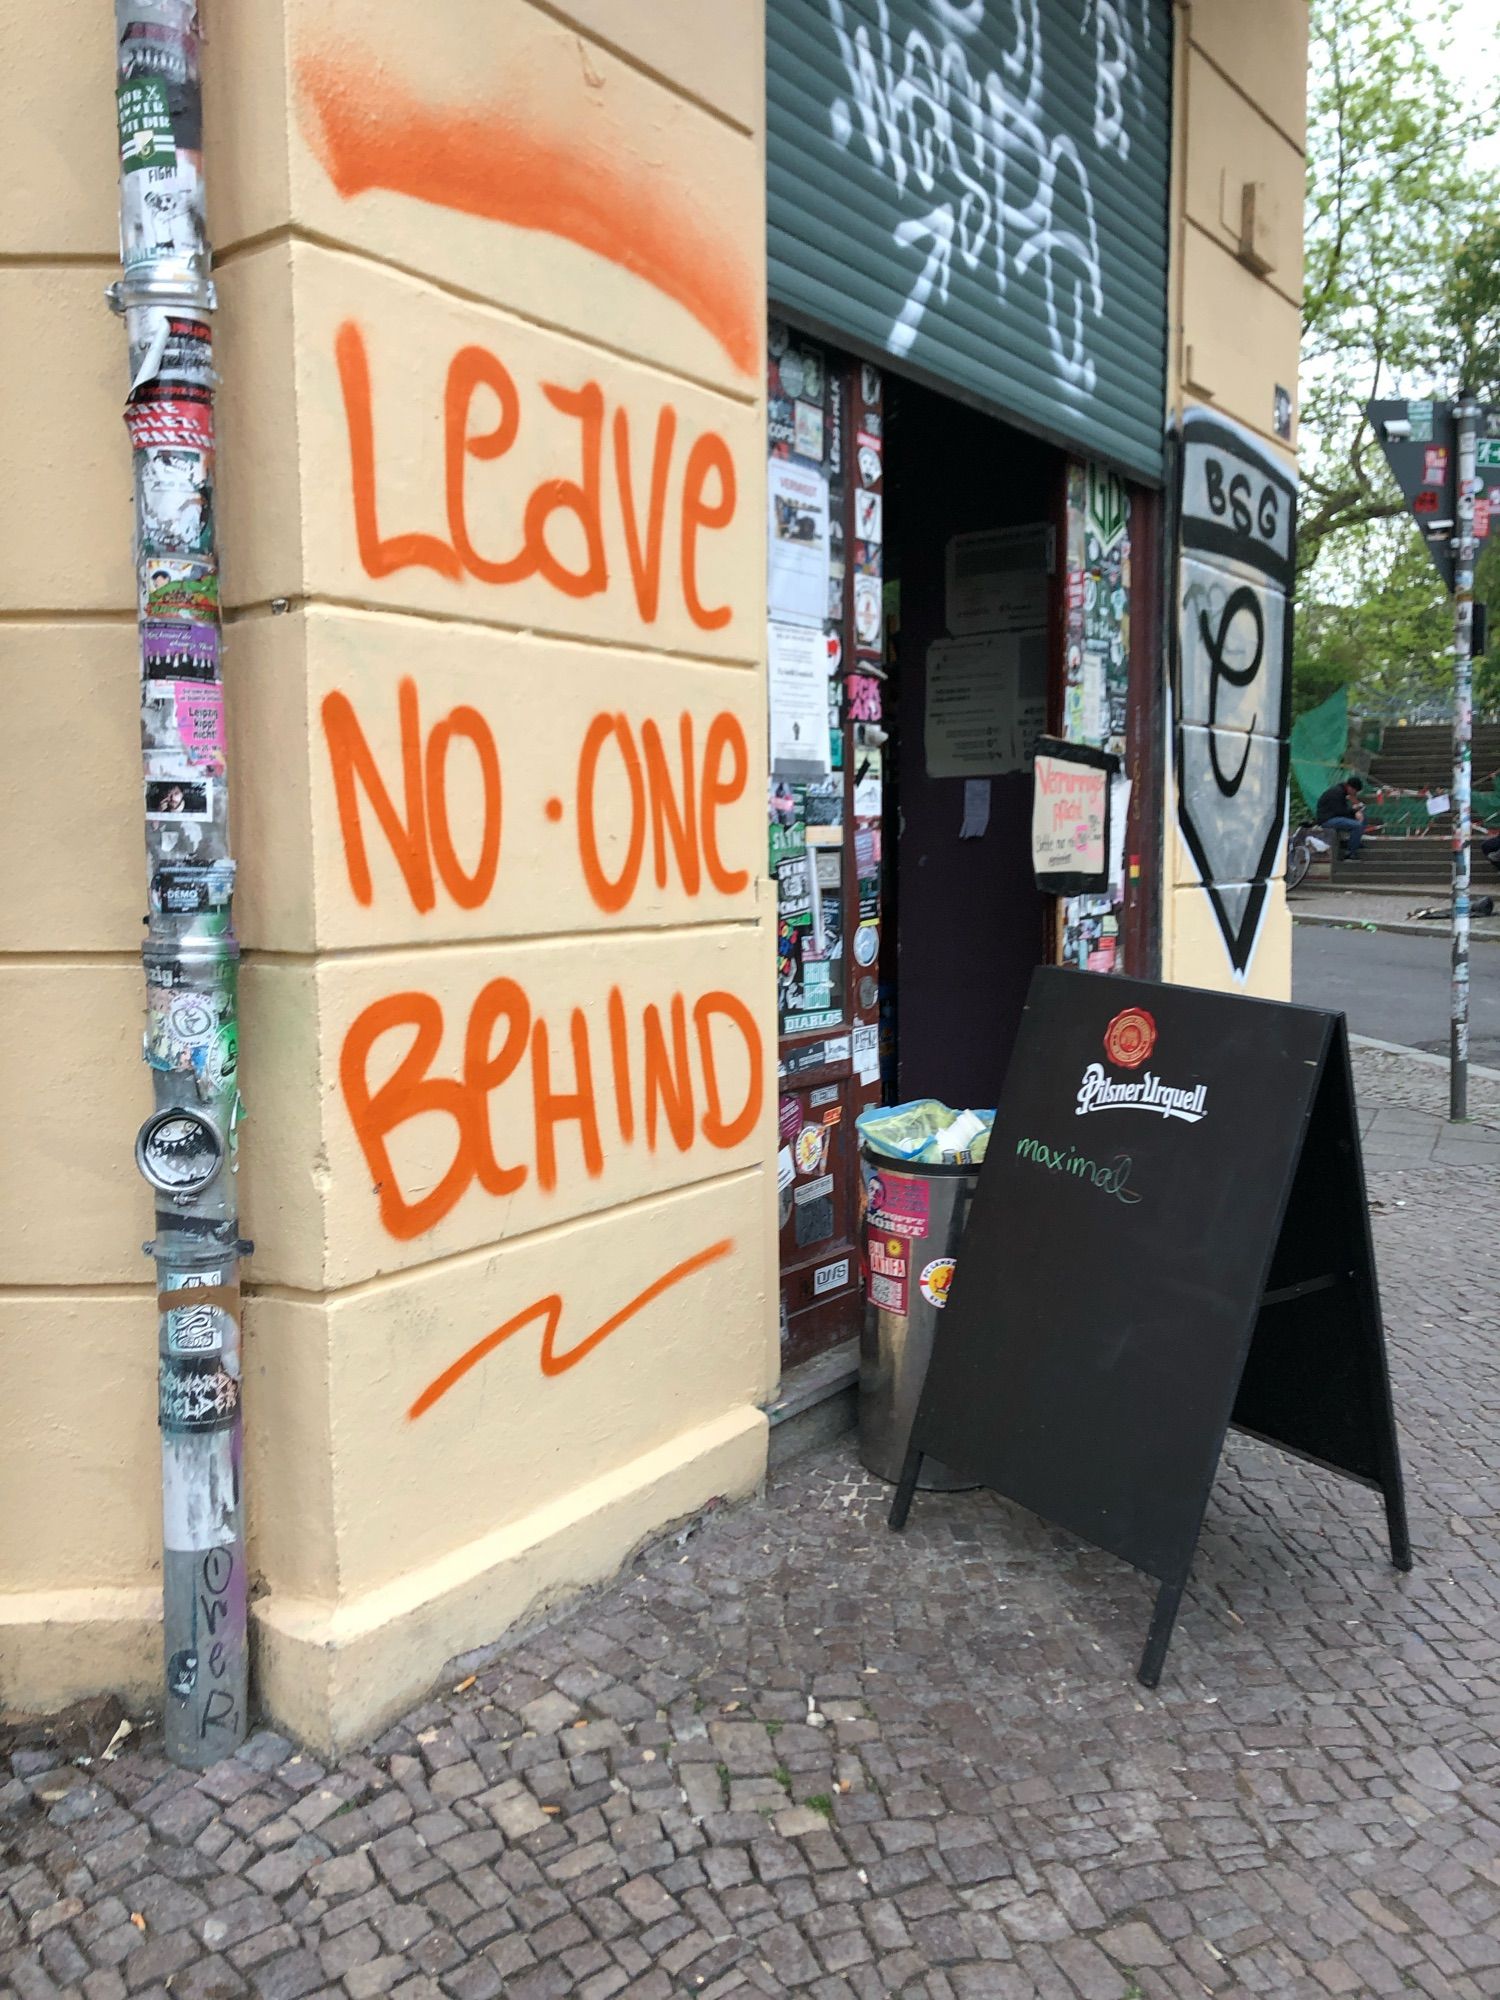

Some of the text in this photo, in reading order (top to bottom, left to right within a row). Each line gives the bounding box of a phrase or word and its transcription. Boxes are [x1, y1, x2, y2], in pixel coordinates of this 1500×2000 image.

[1205, 457, 1279, 539] BSG
[188, 707, 218, 720] Leipzig
[322, 677, 502, 914] NO
[784, 1013, 841, 1032] DIABLOS
[1074, 1061, 1207, 1121] Pilsner Urquell
[1016, 1137, 1143, 1205] maximal
